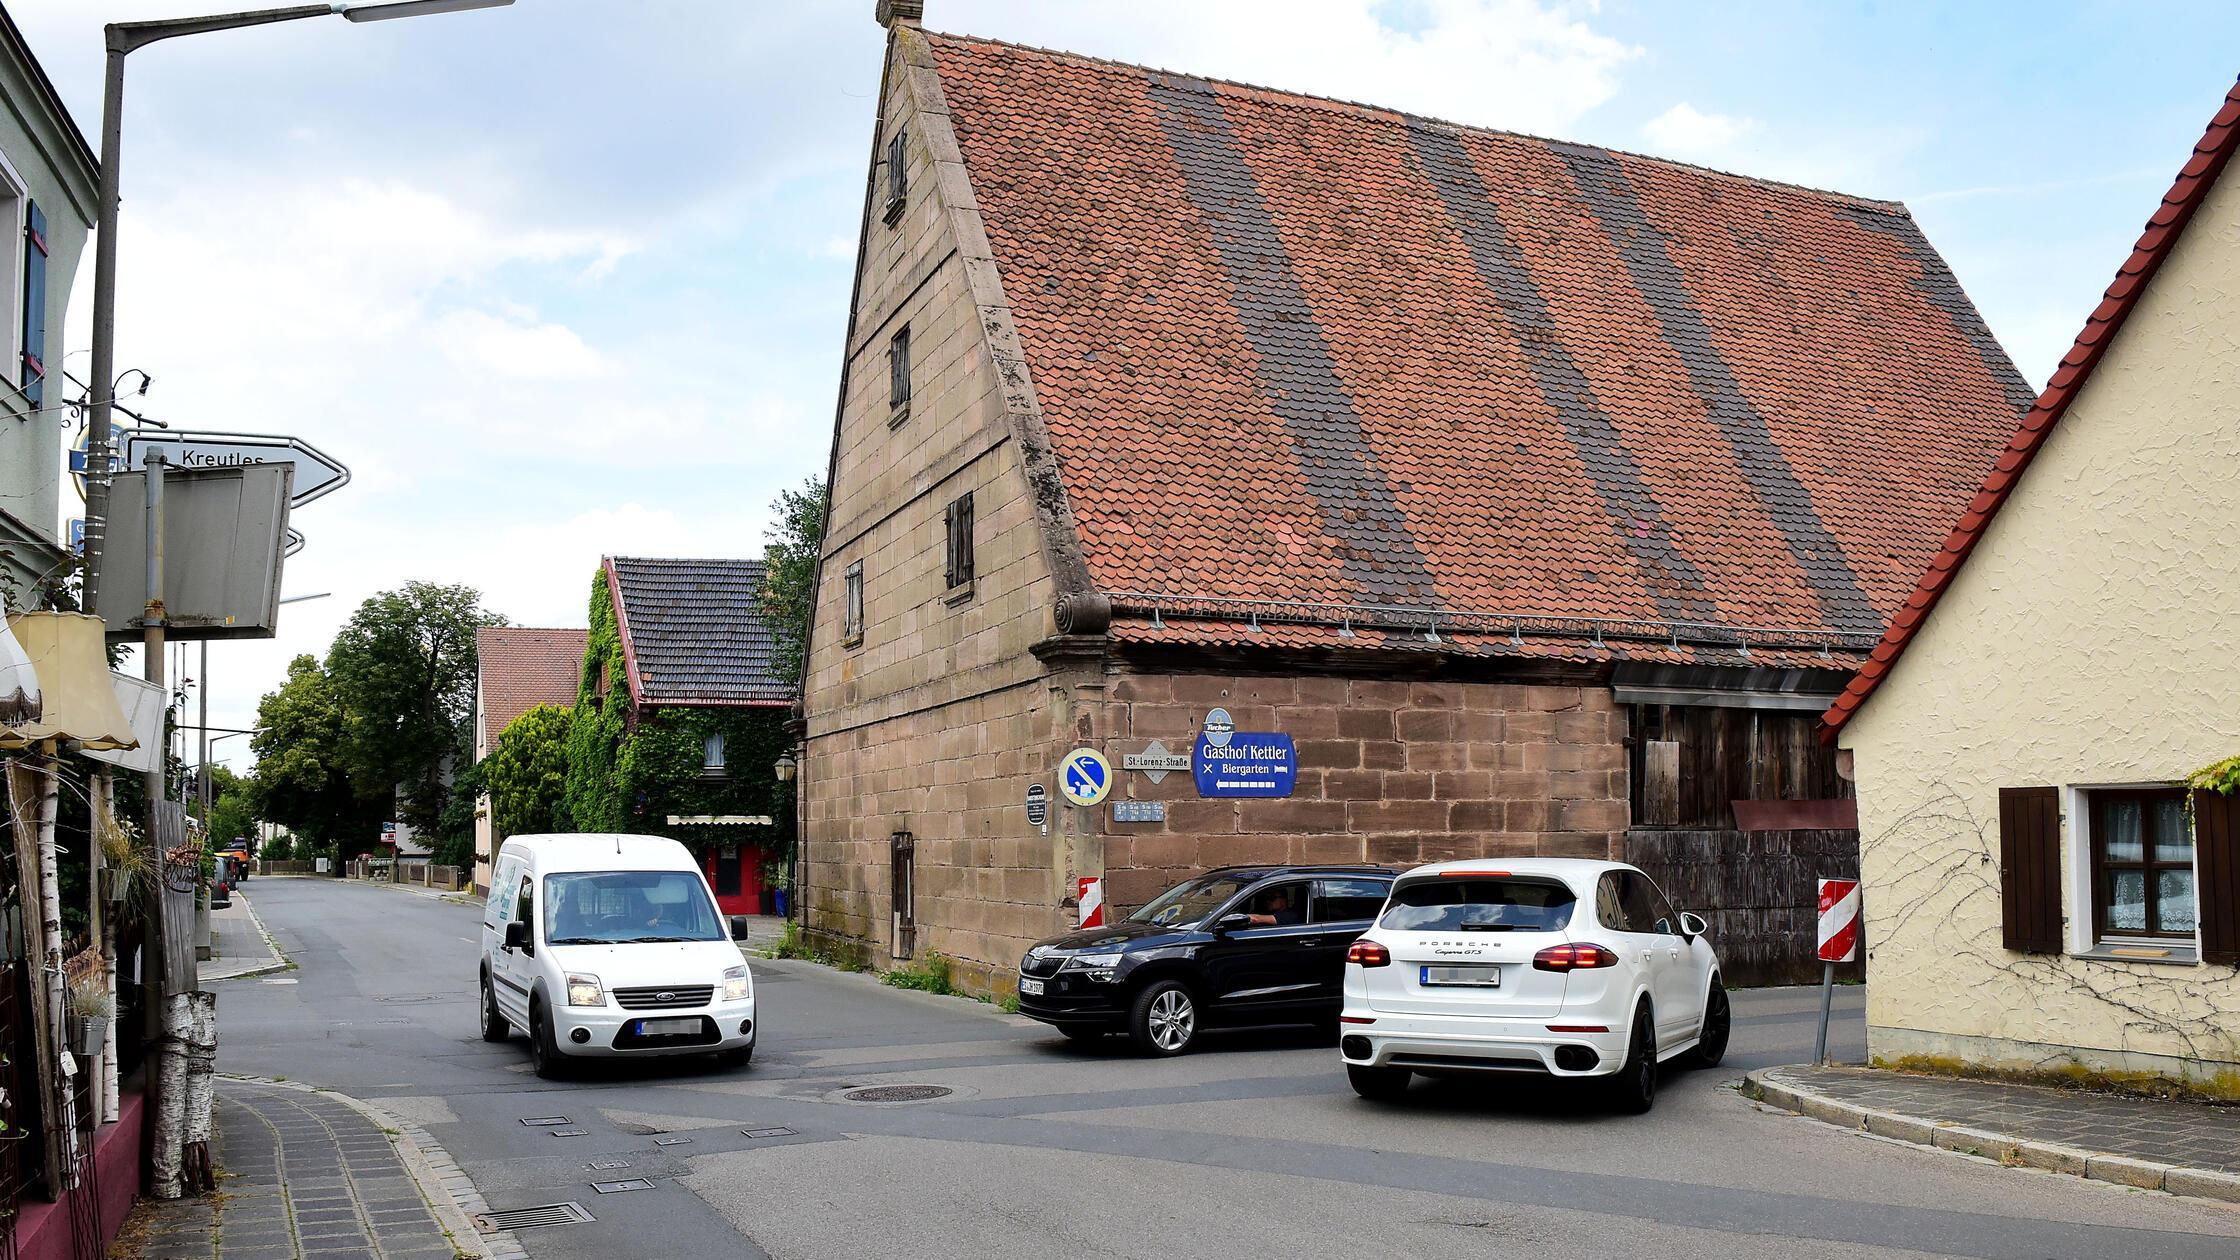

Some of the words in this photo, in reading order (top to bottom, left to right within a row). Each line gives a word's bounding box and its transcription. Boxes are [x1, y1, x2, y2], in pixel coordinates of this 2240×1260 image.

[183, 450, 264, 465] Kreutles
[1203, 744, 1248, 760] Gasthof
[1250, 745, 1287, 760] Kettler
[1128, 756, 1188, 767] St.-Lorenz-Straße
[1222, 763, 1269, 776] Biergarten
